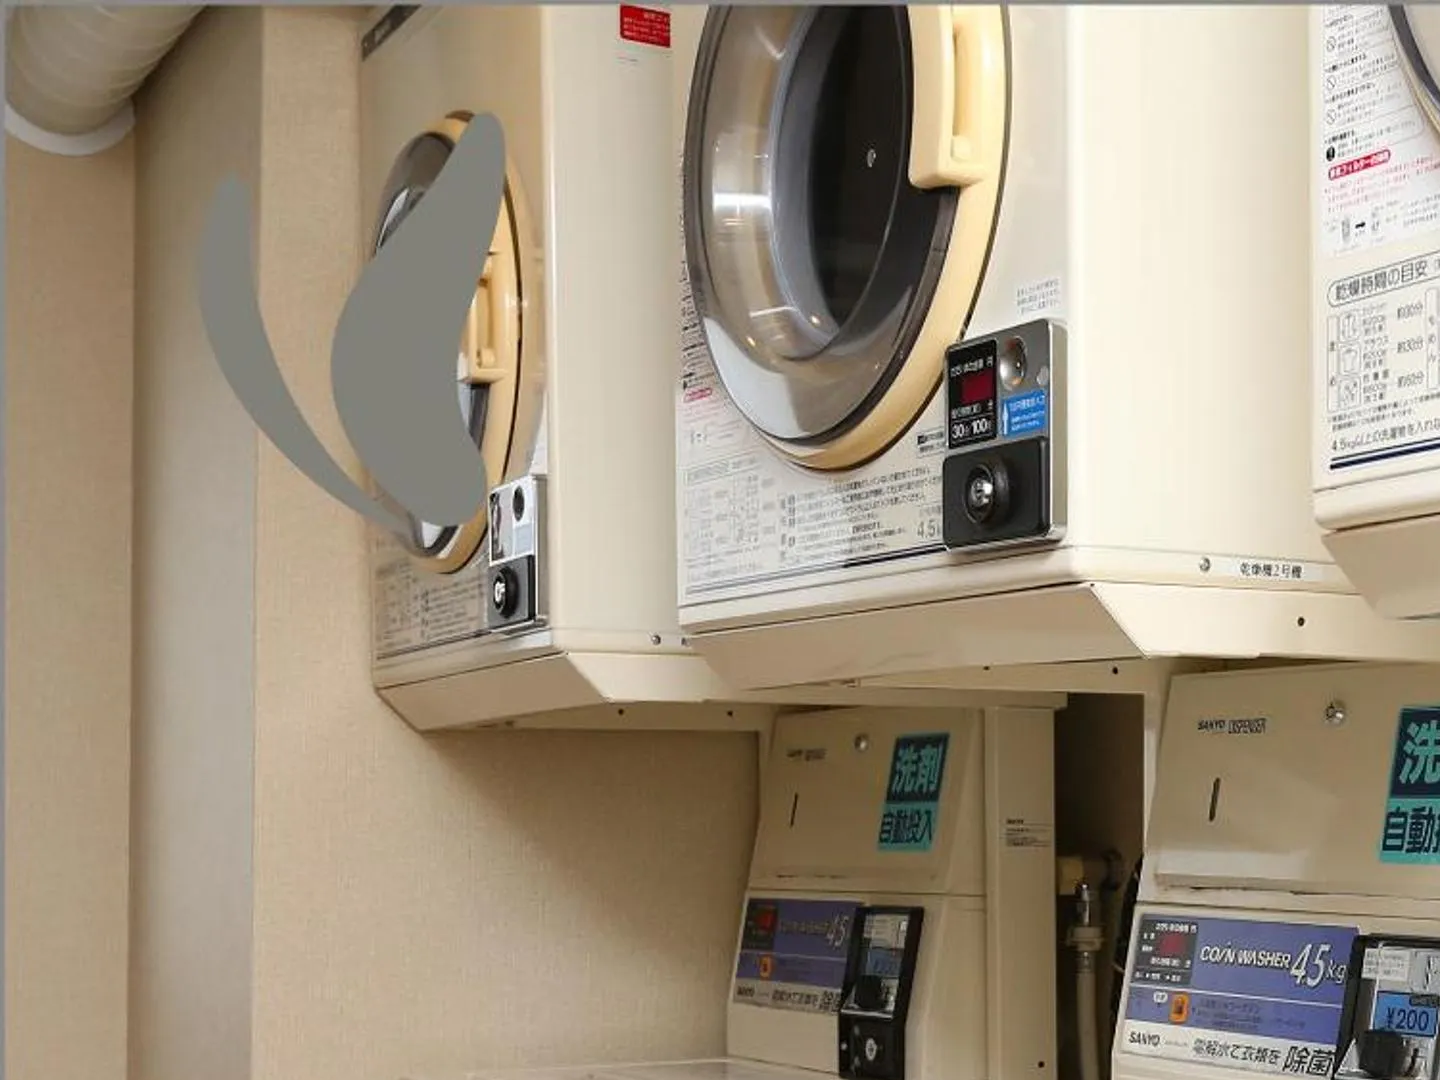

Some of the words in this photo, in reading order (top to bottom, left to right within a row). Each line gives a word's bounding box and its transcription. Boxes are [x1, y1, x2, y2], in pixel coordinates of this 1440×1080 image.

[893, 746, 943, 794] 洗剤
[880, 811, 933, 844] 自動投入
[1200, 941, 1235, 965] COIN
[1237, 950, 1291, 970] WASHER
[1129, 1031, 1161, 1047] SANYO
[1282, 1046, 1335, 1076] 除菌
